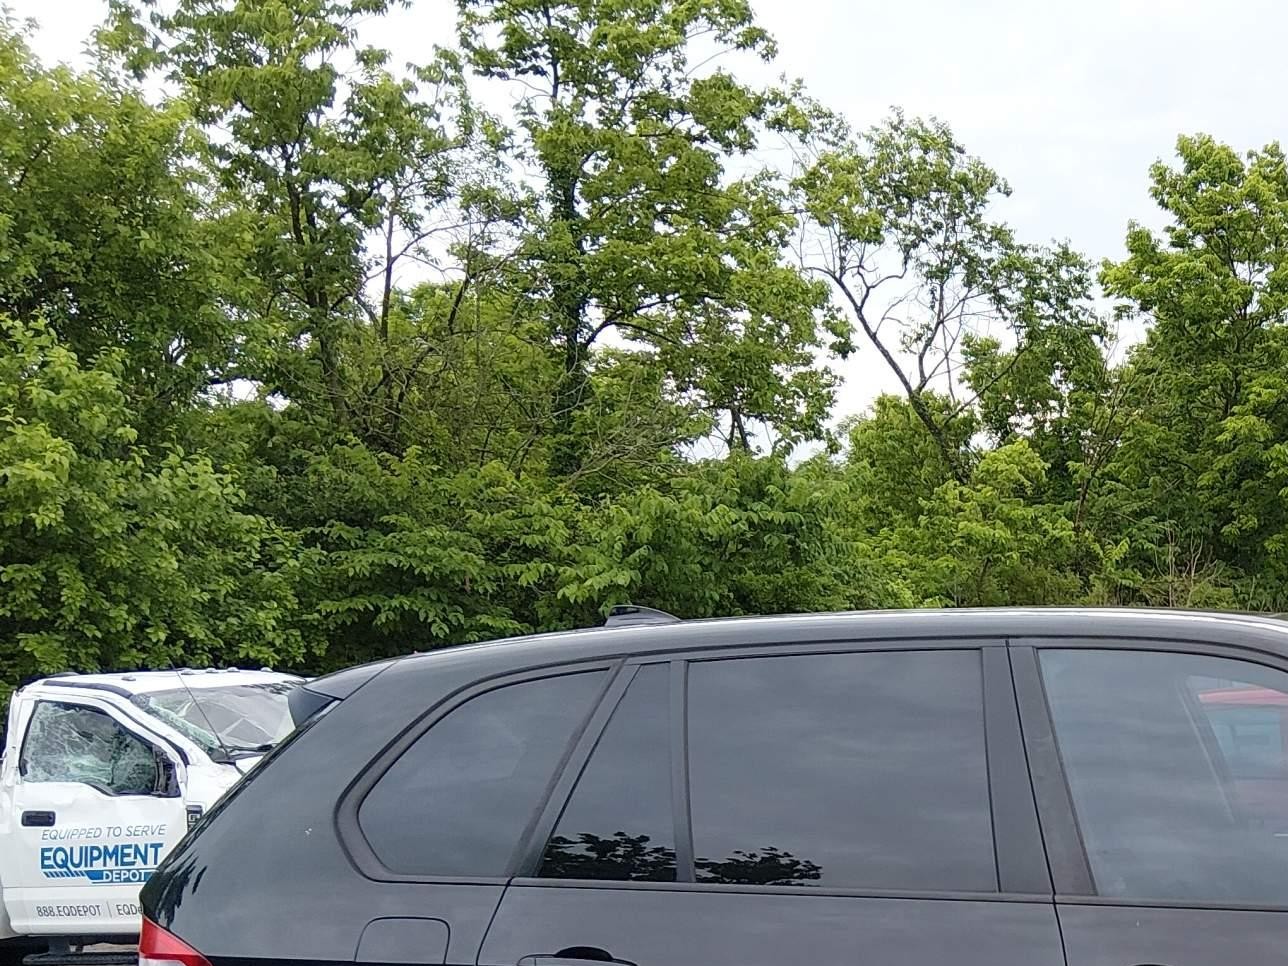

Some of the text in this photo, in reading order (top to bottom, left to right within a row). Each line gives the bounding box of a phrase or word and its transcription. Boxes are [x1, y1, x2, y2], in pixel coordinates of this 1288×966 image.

[41, 824, 167, 841] EQUIPPED TO SERVE
[40, 842, 164, 871] EQUIPMENT
[103, 870, 145, 883] DEPOT
[36, 904, 101, 918] 888.EQDEPOT
